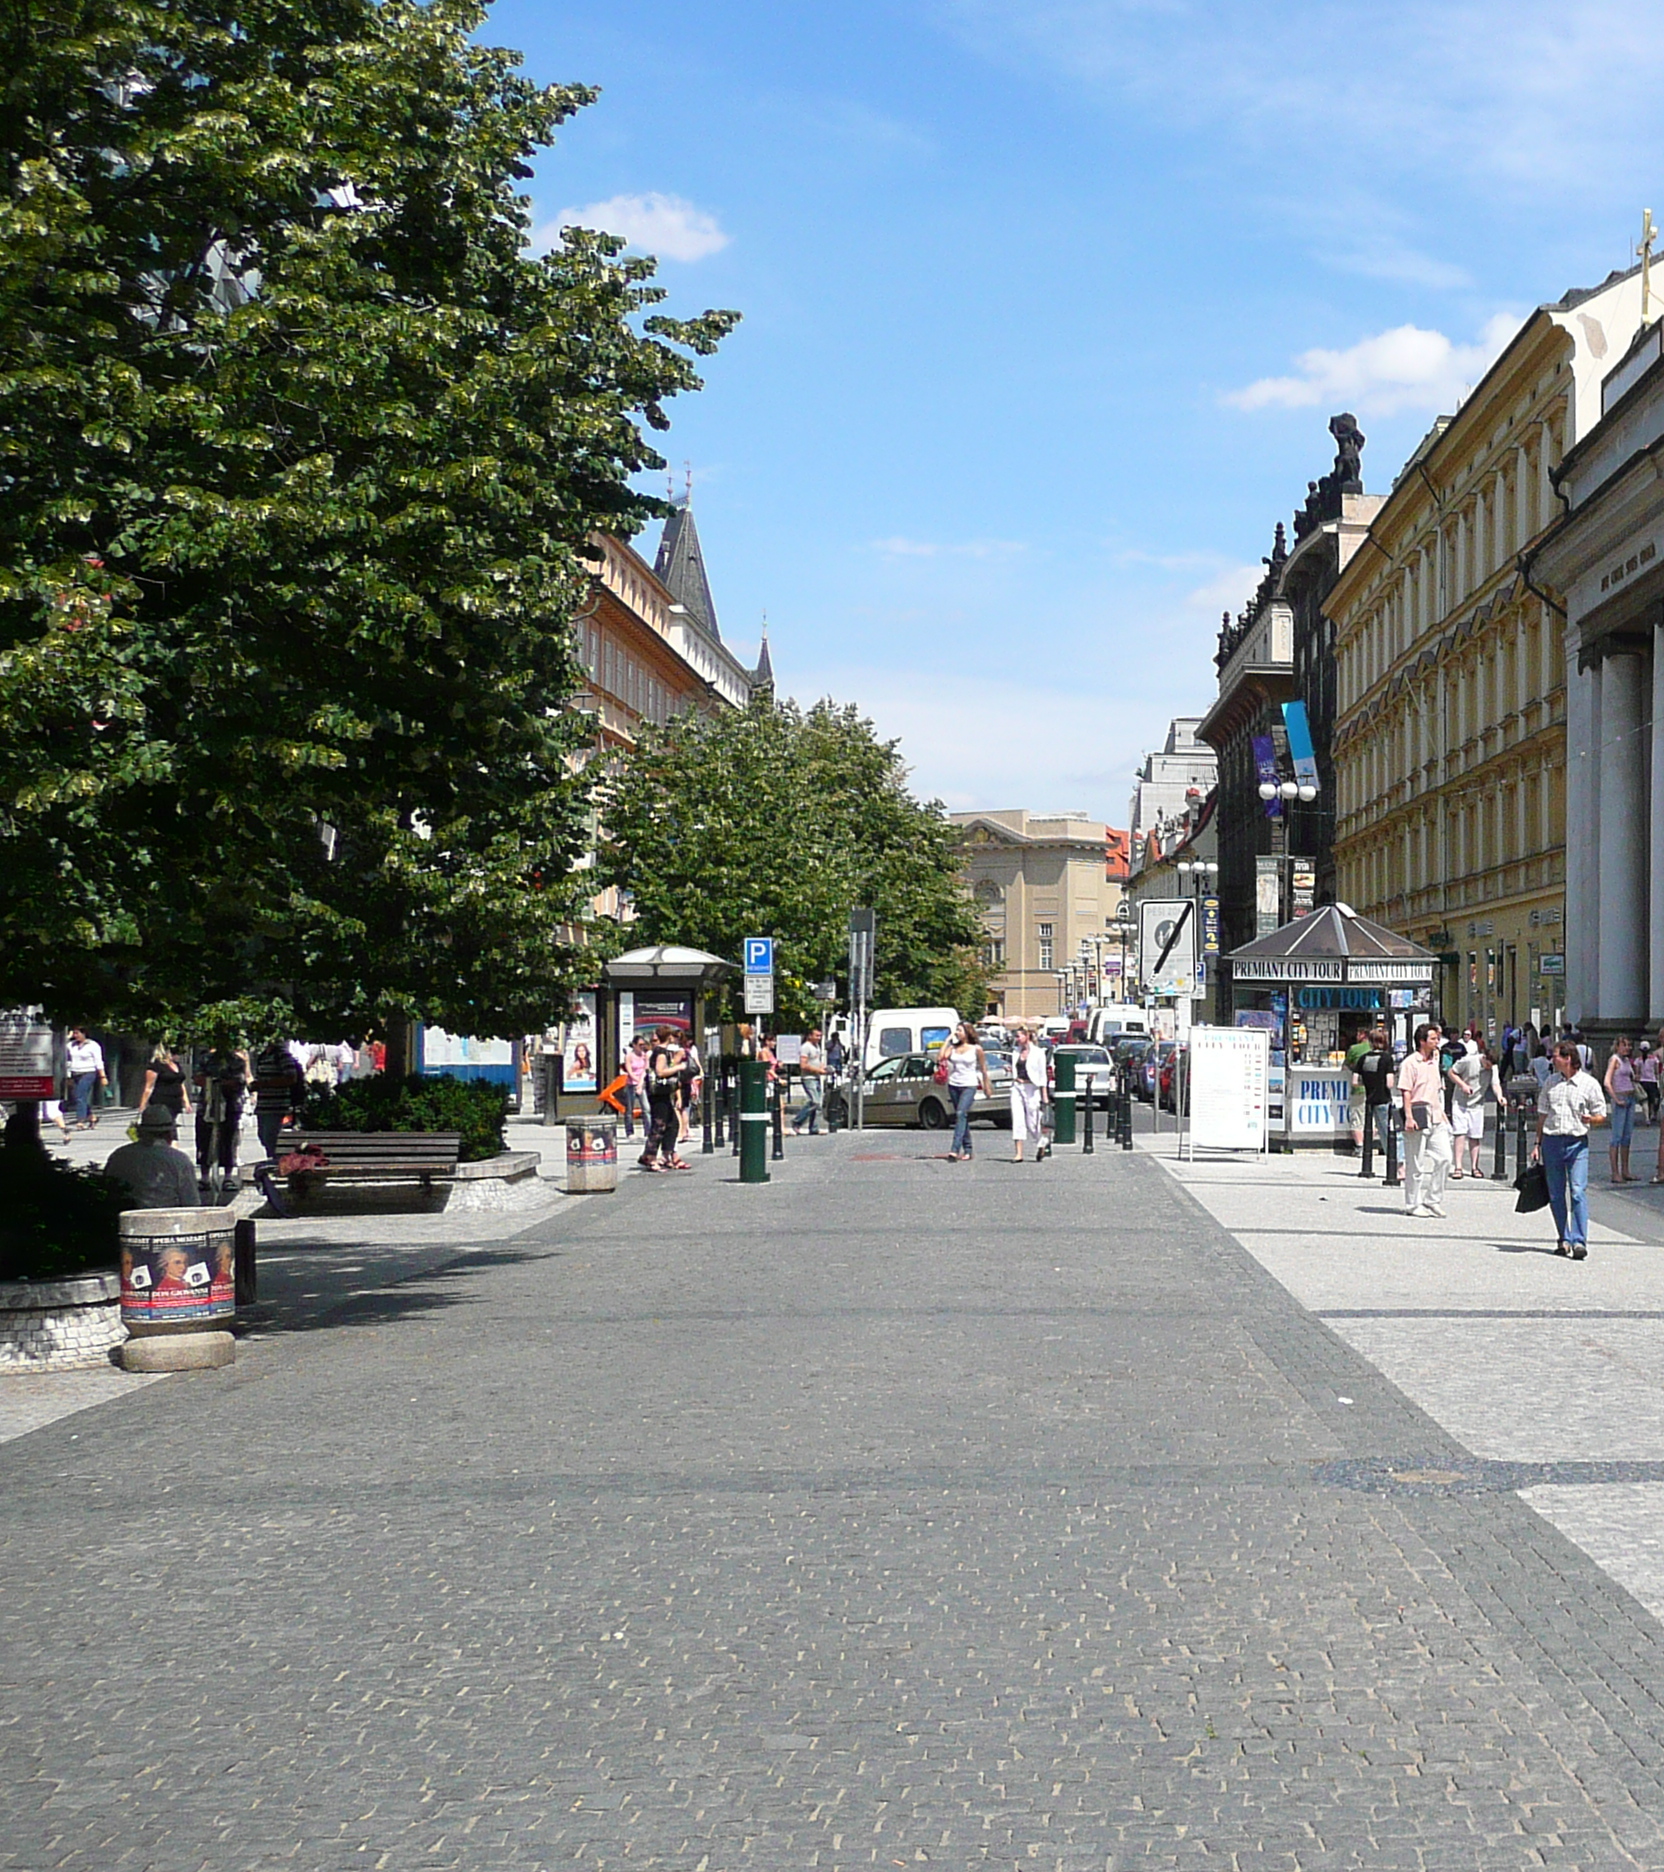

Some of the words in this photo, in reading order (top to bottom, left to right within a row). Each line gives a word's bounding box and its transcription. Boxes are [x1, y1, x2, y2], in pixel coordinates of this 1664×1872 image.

[750, 942, 766, 964] P
[1234, 962, 1284, 978] PREMIANT
[1287, 962, 1308, 978] CITY
[1313, 963, 1340, 978] TOUR
[1299, 988, 1332, 1008] CITY
[1338, 988, 1380, 1008] TOUR
[1298, 1104, 1332, 1124] CITY
